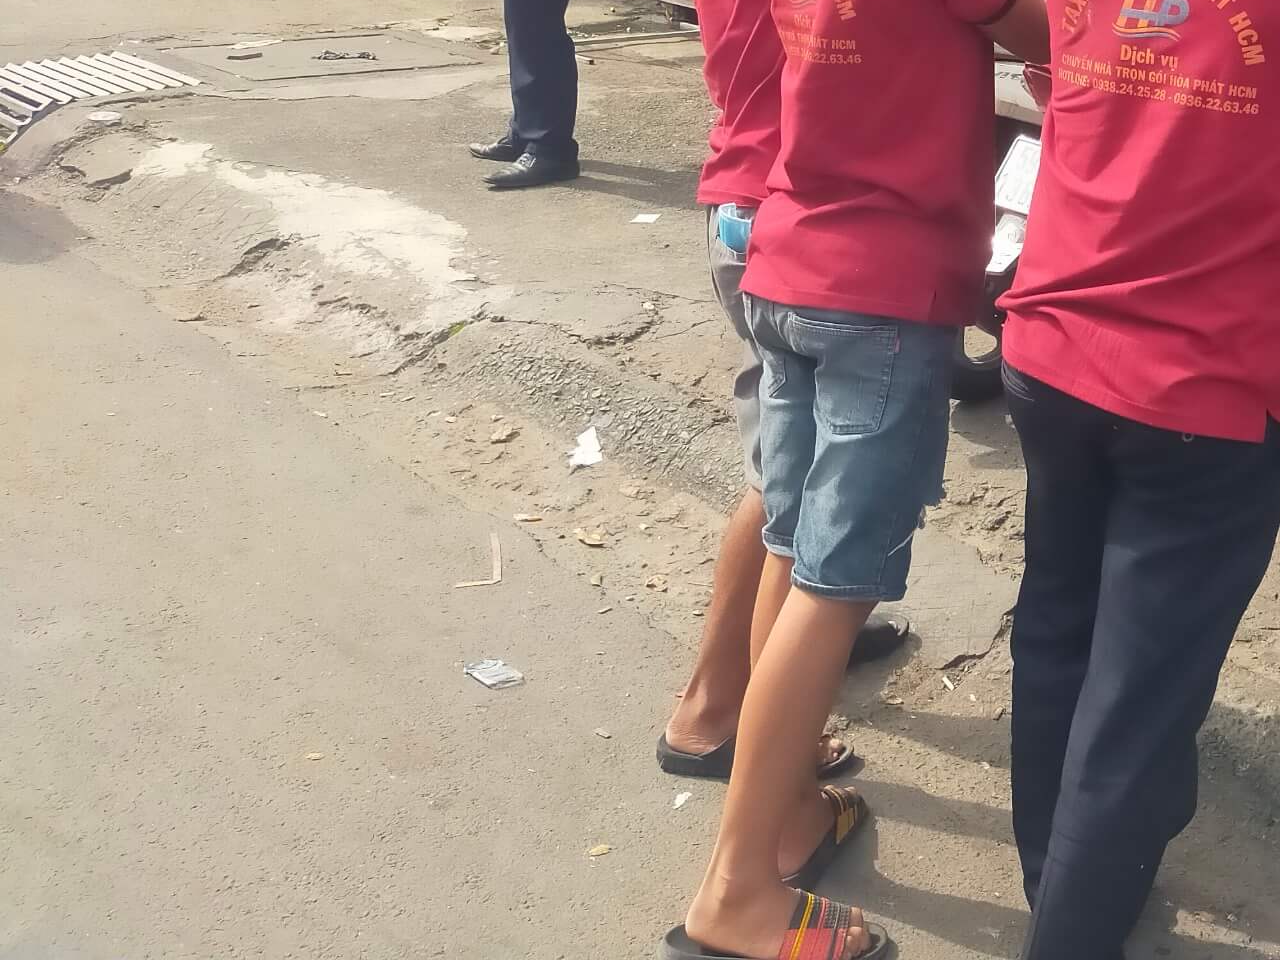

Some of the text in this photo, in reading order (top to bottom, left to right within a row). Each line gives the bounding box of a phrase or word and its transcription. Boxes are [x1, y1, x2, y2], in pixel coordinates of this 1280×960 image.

[1228, 11, 1265, 67] HCM
[1120, 44, 1155, 66] Dịch
[1094, 60, 1112, 77] NHÀ
[1115, 66, 1146, 83] TRỌN
[1194, 78, 1225, 95] PHÁT
[1229, 85, 1257, 99] HCM
[1173, 92, 1260, 115] 0936.22.63.46
